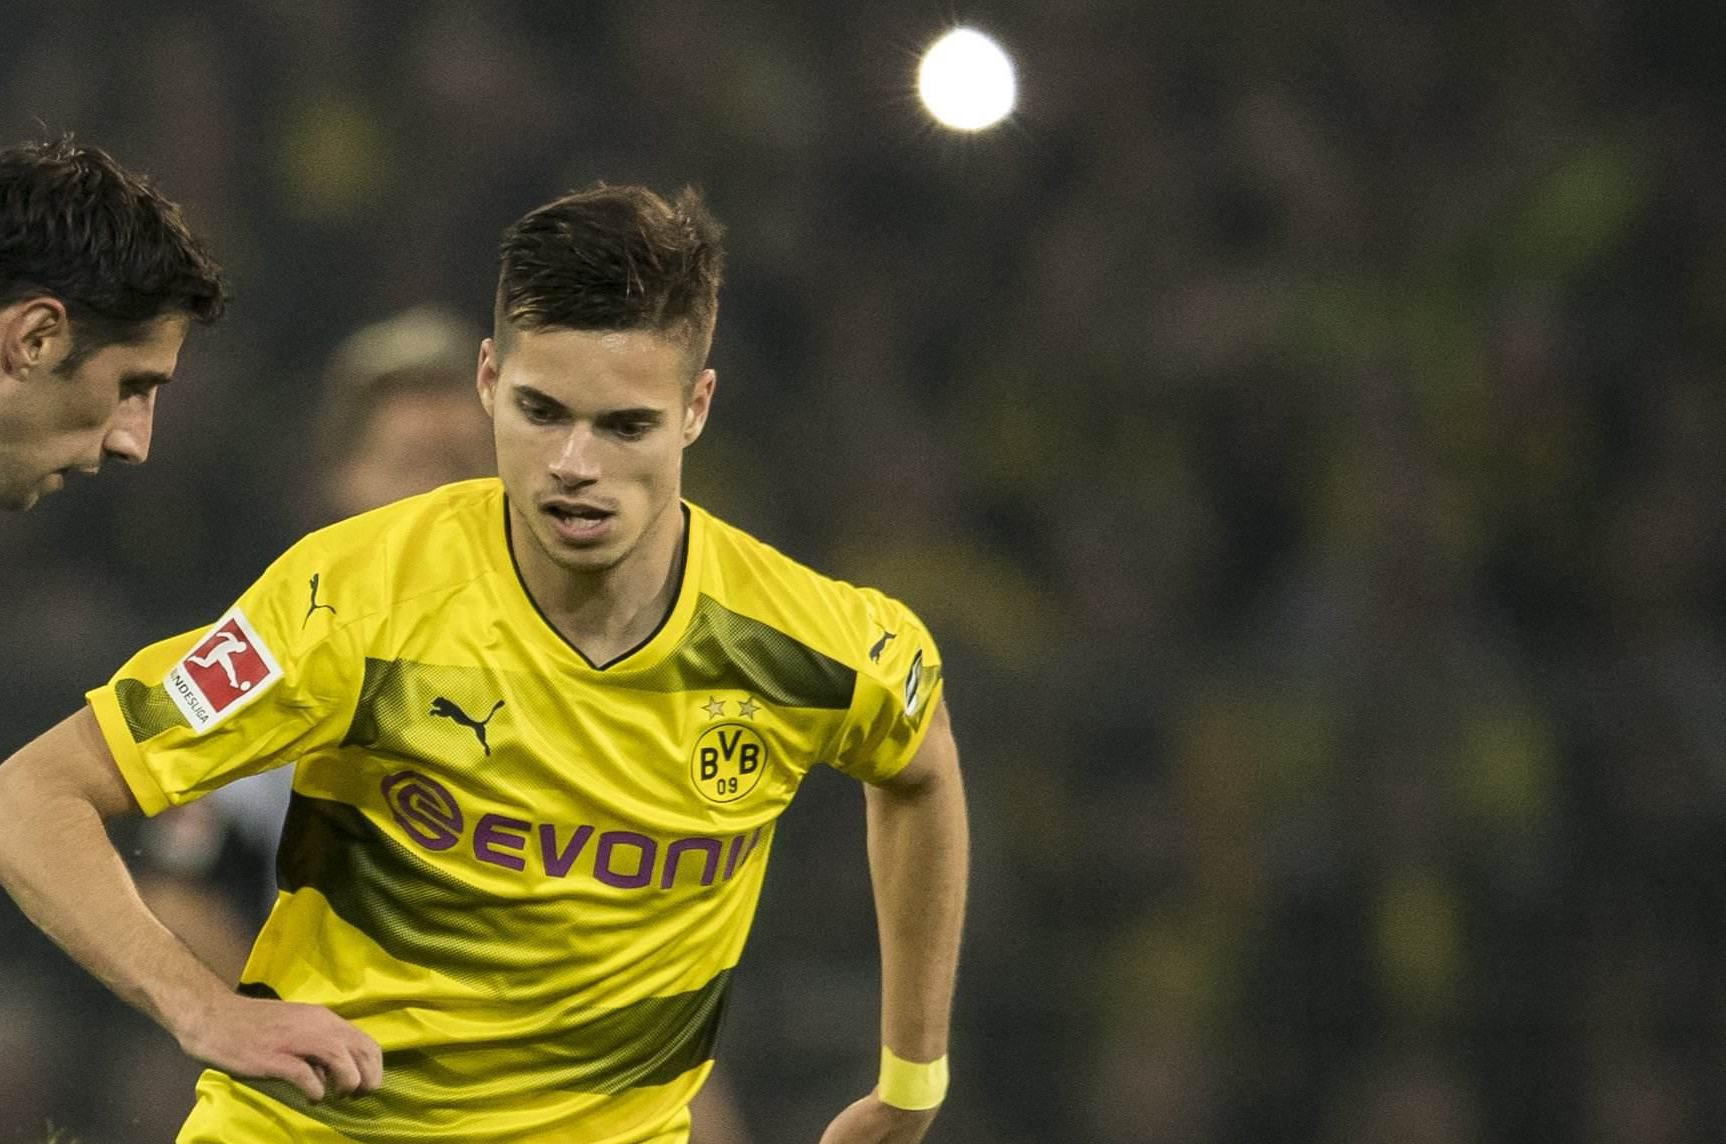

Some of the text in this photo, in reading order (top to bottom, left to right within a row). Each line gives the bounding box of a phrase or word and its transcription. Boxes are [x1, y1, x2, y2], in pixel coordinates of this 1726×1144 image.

[170, 668, 209, 724] NDESLIGA
[700, 730, 759, 780] BVB
[717, 776, 738, 795] 09
